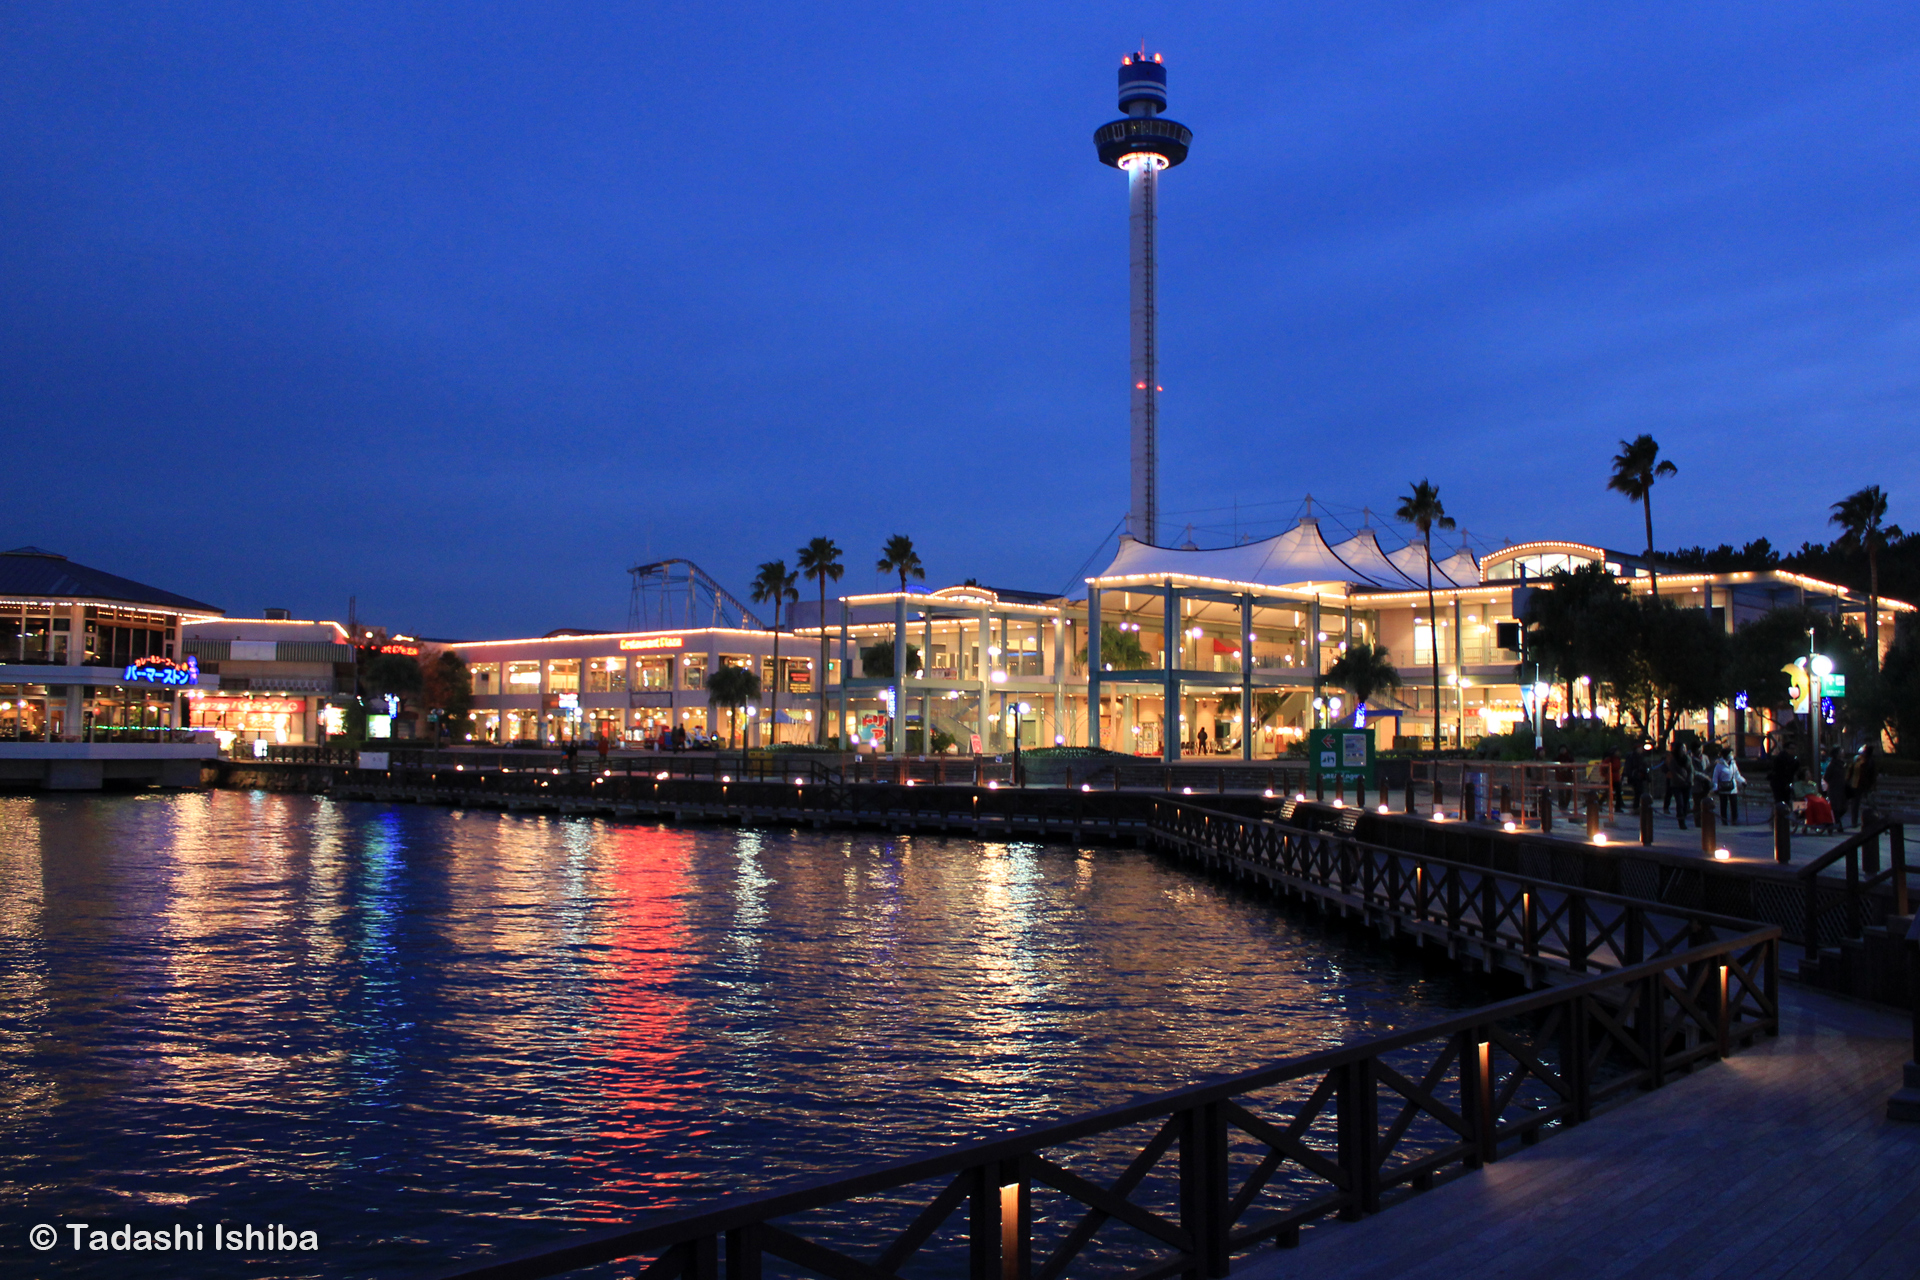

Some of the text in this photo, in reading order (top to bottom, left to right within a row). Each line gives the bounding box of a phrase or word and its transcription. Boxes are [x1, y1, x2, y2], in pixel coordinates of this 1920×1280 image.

[124, 665, 189, 685] パーマーストン
